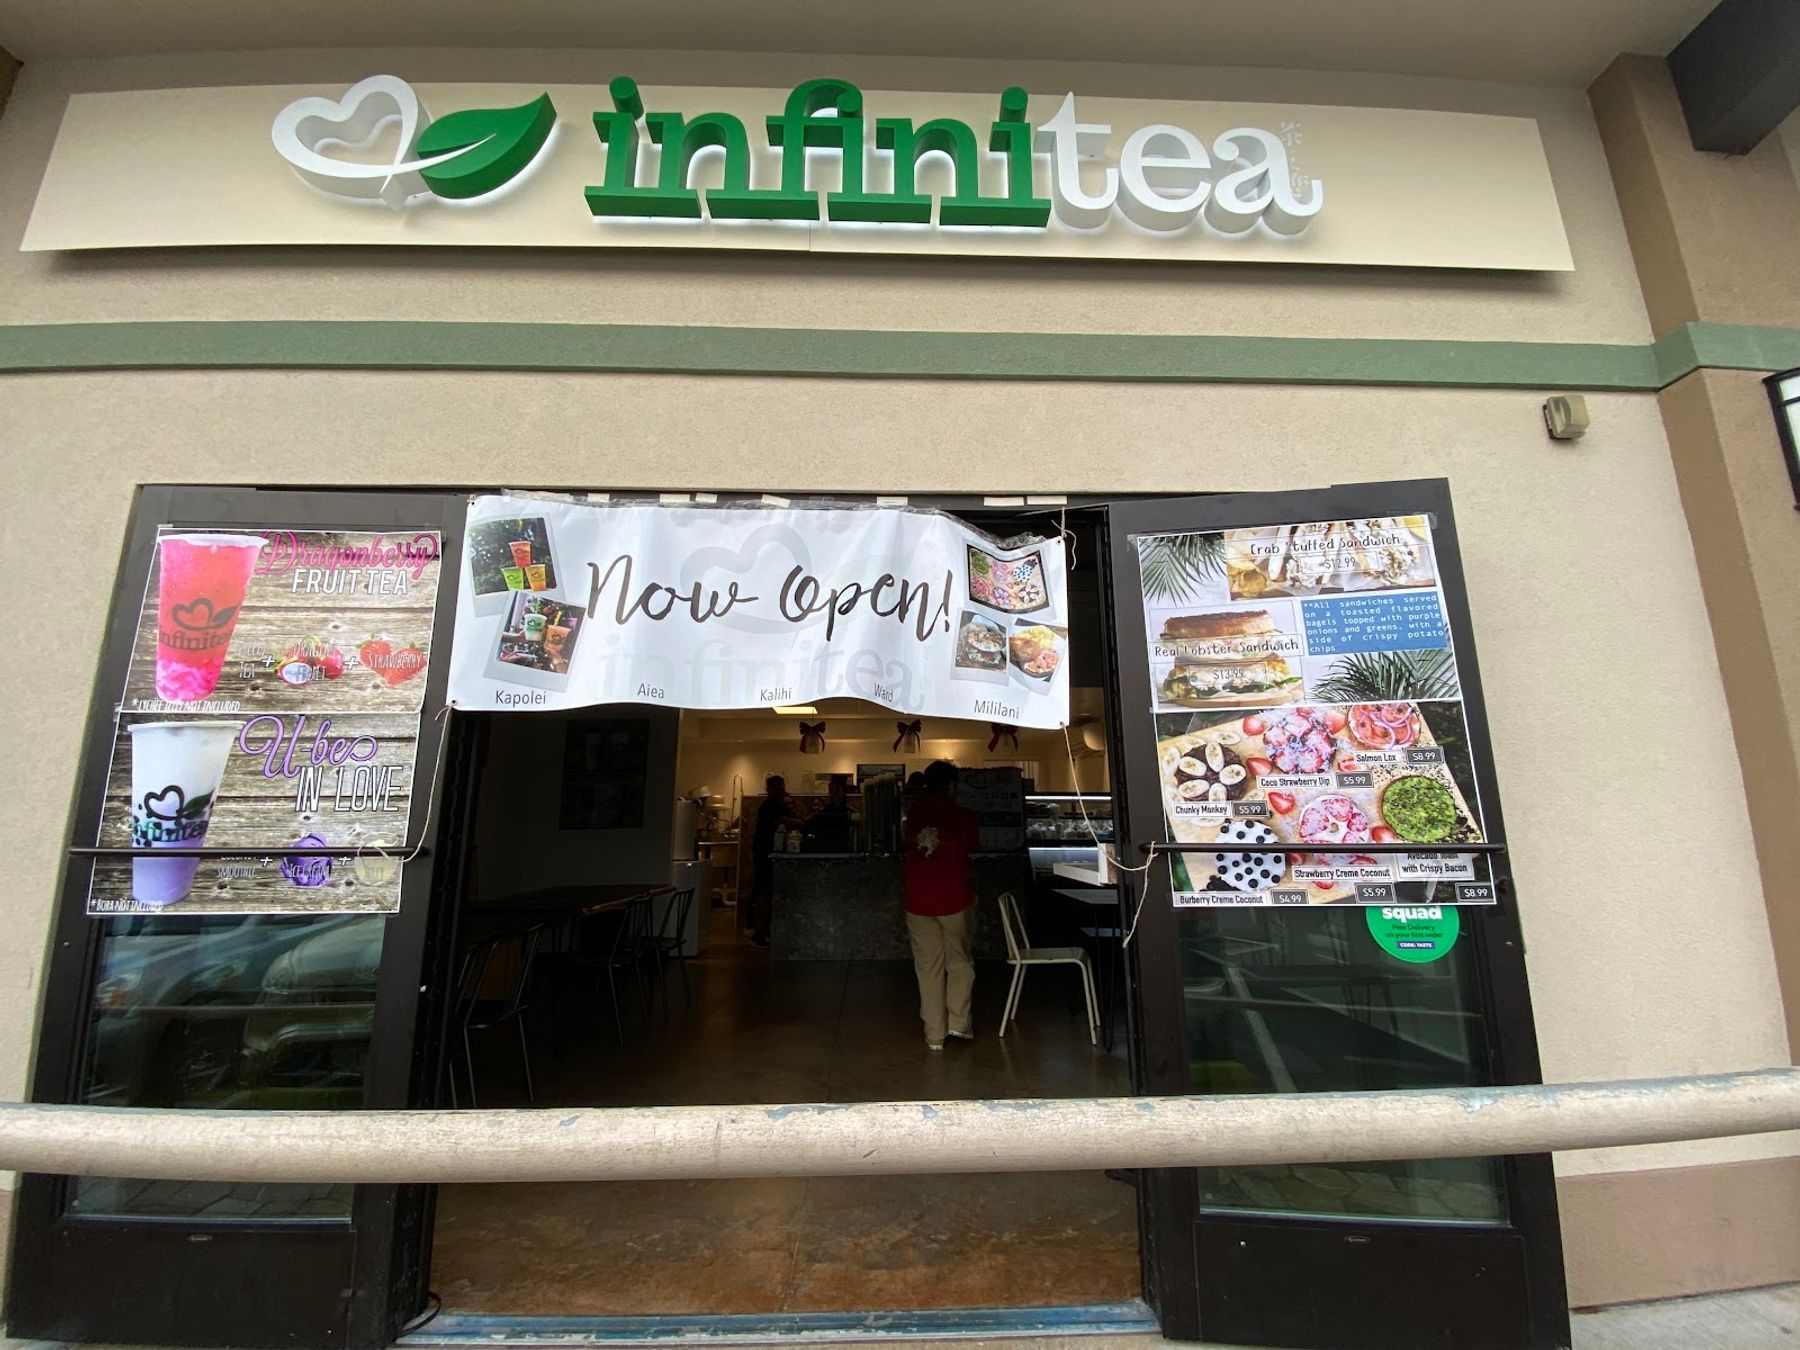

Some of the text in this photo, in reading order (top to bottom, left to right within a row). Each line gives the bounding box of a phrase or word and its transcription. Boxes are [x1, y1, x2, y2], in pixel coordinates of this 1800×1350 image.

[583, 75, 1325, 235] infinitea
[1250, 533, 1401, 556] Crab Stuffed Sandwich
[255, 530, 438, 581] Dragonberry
[291, 568, 408, 595] FRUIT TEA
[586, 554, 953, 643] Now Open!
[1339, 598, 1395, 608] sandwiches
[1403, 594, 1437, 603] served
[1340, 607, 1381, 616] toasted
[1391, 603, 1439, 613] flavored
[1305, 612, 1441, 628] bagels topped with purple
[1307, 627, 1339, 635] onions
[1344, 625, 1361, 633] and
[1408, 621, 1431, 629] with
[1308, 629, 1445, 644] side of crispy potato
[1154, 638, 1300, 657] Real Lobster Sandwich
[1309, 645, 1336, 654] chips
[637, 683, 665, 699] Aiea
[760, 687, 792, 701] Kalihi
[873, 683, 894, 702] Ward
[495, 690, 547, 708] Kapolei
[974, 700, 1020, 719] Mililani
[1356, 752, 1382, 763] Salmon
[1412, 751, 1436, 761] $8.99
[1260, 776, 1331, 787] Coco Strawberry Dip
[1343, 776, 1366, 785] $5.99
[295, 765, 404, 812] IN LOVE
[1175, 804, 1228, 815] Chunky Monkey
[1239, 805, 1261, 814] $5.99
[1294, 867, 1391, 879] Strawberry Creme Coconut
[1401, 863, 1468, 875] with Crispy Bacon
[1362, 886, 1386, 897] $5.99
[1463, 887, 1488, 898] $8.99
[1279, 895, 1302, 903] $4.99
[1382, 906, 1442, 923] squad
